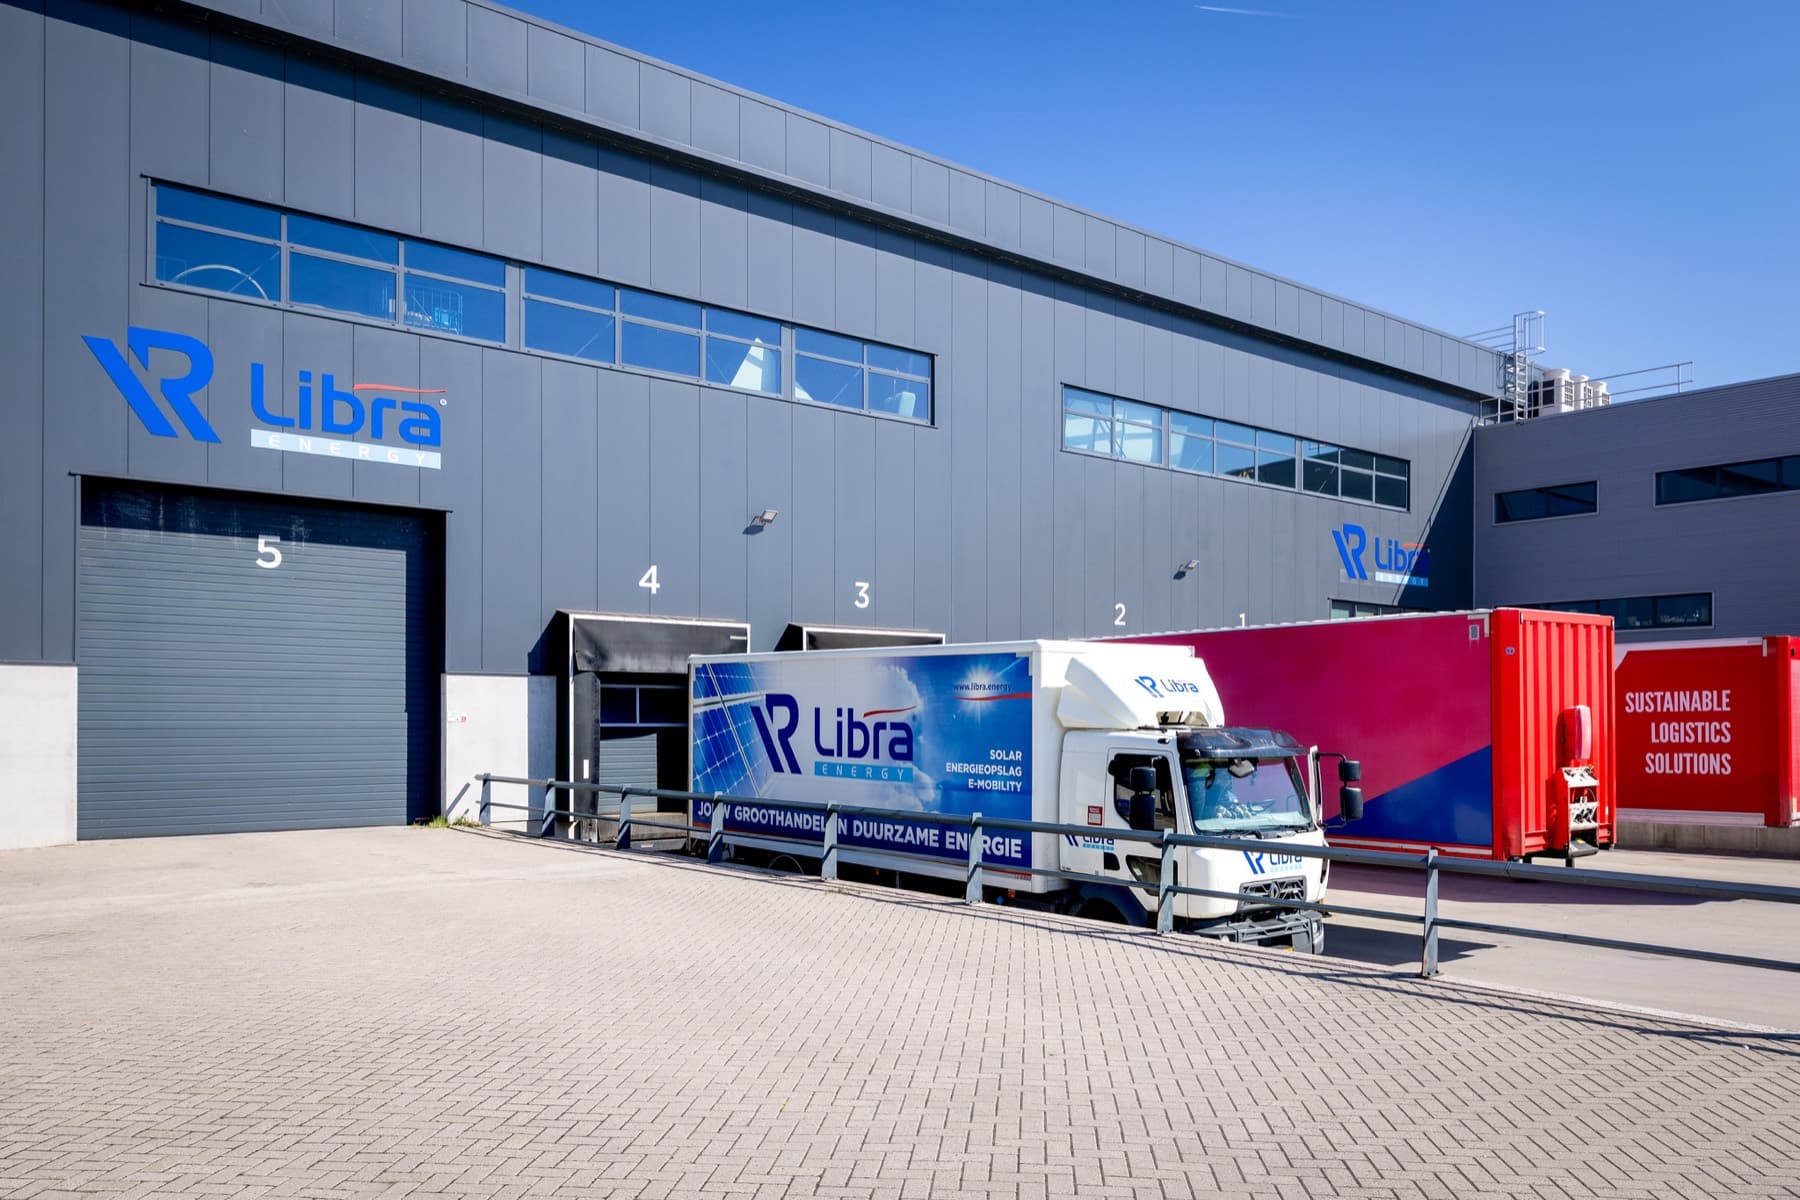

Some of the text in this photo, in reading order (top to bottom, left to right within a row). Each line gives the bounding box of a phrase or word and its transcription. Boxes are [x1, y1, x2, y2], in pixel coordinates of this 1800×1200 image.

[250, 362, 441, 446] Libra
[267, 434, 426, 466] ENERGY
[255, 534, 283, 569] 5
[1374, 537, 1430, 575] Libra
[638, 565, 661, 594] 4
[854, 581, 870, 609] 3
[1114, 602, 1126, 626] 2
[1239, 612, 1246, 628] 1
[953, 682, 1012, 692] www.libra.energy
[1160, 679, 1199, 693] Libra
[1625, 689, 1731, 713] SUSTAINABLE
[814, 707, 914, 762] Libra
[1651, 721, 1731, 744] LOGISTICS
[989, 749, 1022, 761] SOLAR
[1645, 752, 1731, 776] SOLUTIONS
[821, 763, 905, 780] ENERGY
[945, 762, 1022, 776] ENERGIEOPSLAG
[968, 778, 1022, 792] E-MOBILITY
[697, 801, 731, 820] JOW
[734, 805, 826, 833] GROOTHANDEL
[852, 821, 940, 848] DUURZAME
[945, 830, 1022, 859] ENRGIE
